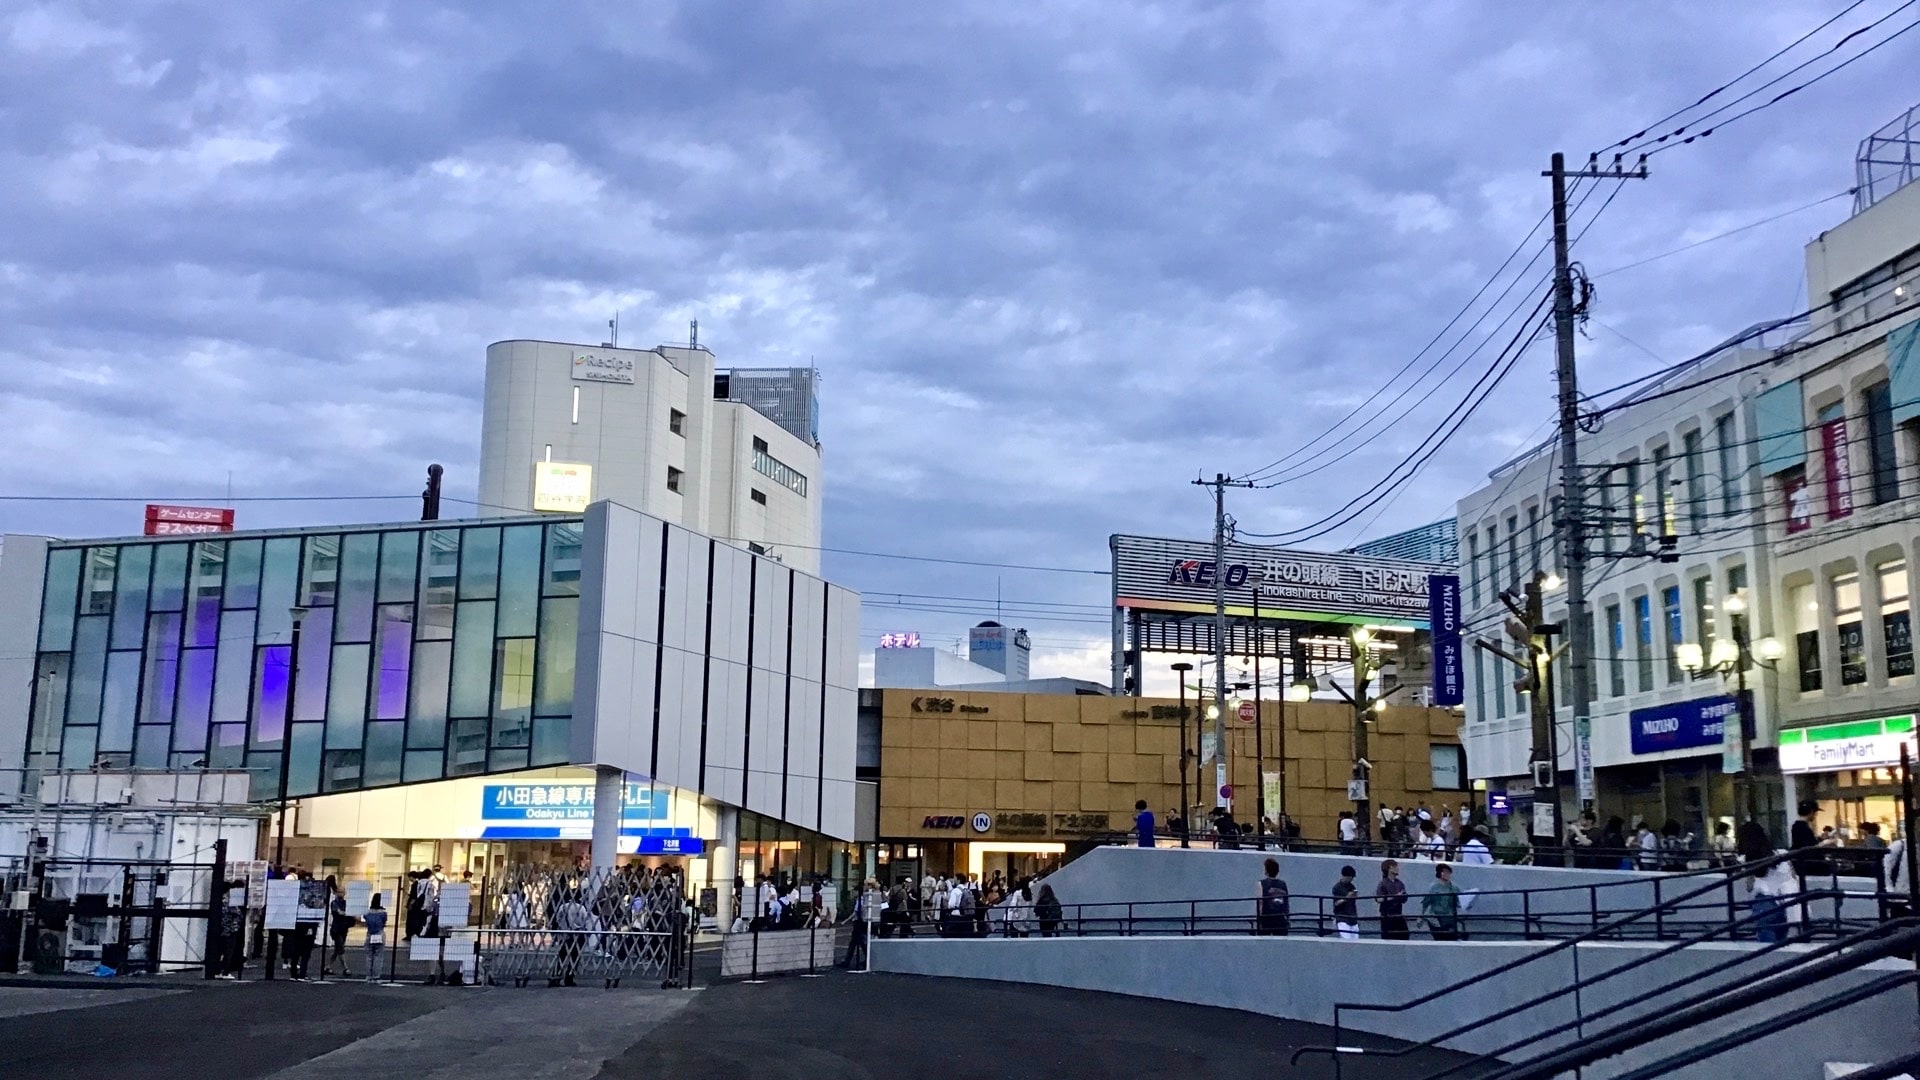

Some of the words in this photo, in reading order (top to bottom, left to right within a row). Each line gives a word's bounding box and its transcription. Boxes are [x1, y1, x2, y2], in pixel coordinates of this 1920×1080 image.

[586, 354, 633, 372] Recipe
[161, 509, 220, 519] ゲームセンター
[1263, 560, 1340, 586] 井の頭線
[1355, 567, 1430, 594] 下北沢駅
[1355, 592, 1430, 608] Shimo-kitazaw
[1443, 584, 1454, 631] MIZUHO
[880, 633, 920, 646] ホテル
[1444, 645, 1456, 696] みずほ銀行
[1642, 718, 1679, 735] MIZUHO
[1814, 742, 1874, 762] FamilyMart
[496, 786, 652, 806] 小田急線専用札口
[526, 808, 564, 820] Odakyu
[567, 808, 589, 818] Line
[923, 816, 964, 828] KEIO
